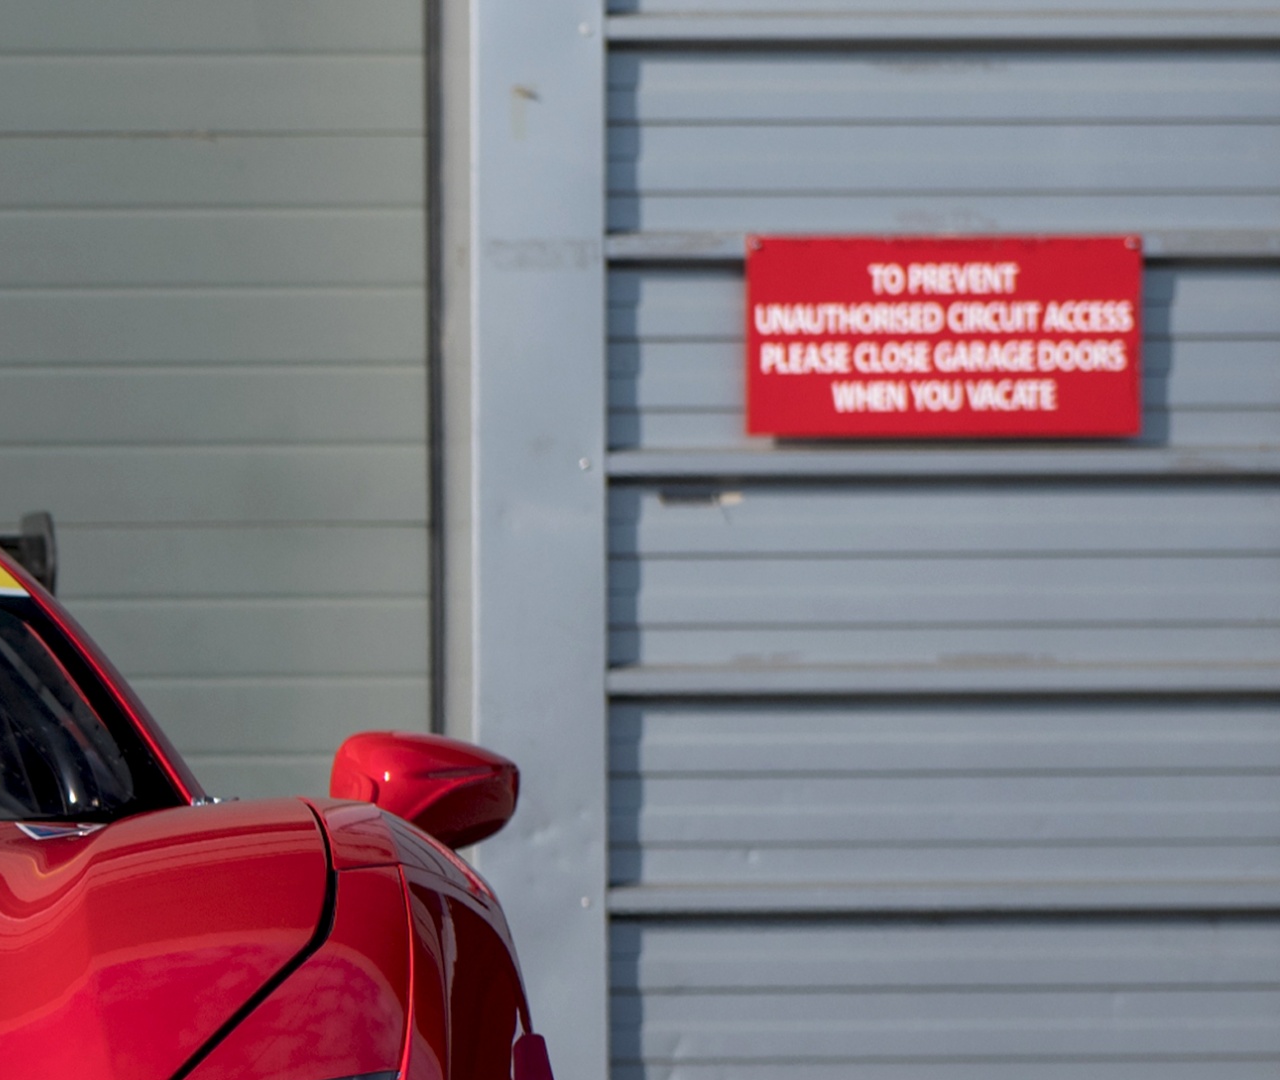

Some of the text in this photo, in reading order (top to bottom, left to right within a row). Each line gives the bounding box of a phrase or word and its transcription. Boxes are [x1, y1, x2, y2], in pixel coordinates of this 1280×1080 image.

[868, 263, 1019, 295] TO PREVENT
[755, 300, 1132, 334] UNAUTHORISED CIRCUIT ACCESS
[761, 340, 1126, 374] PLEASE CLOSE GARAGE DOORS
[832, 380, 1056, 413] WHEN YOU VACATE
